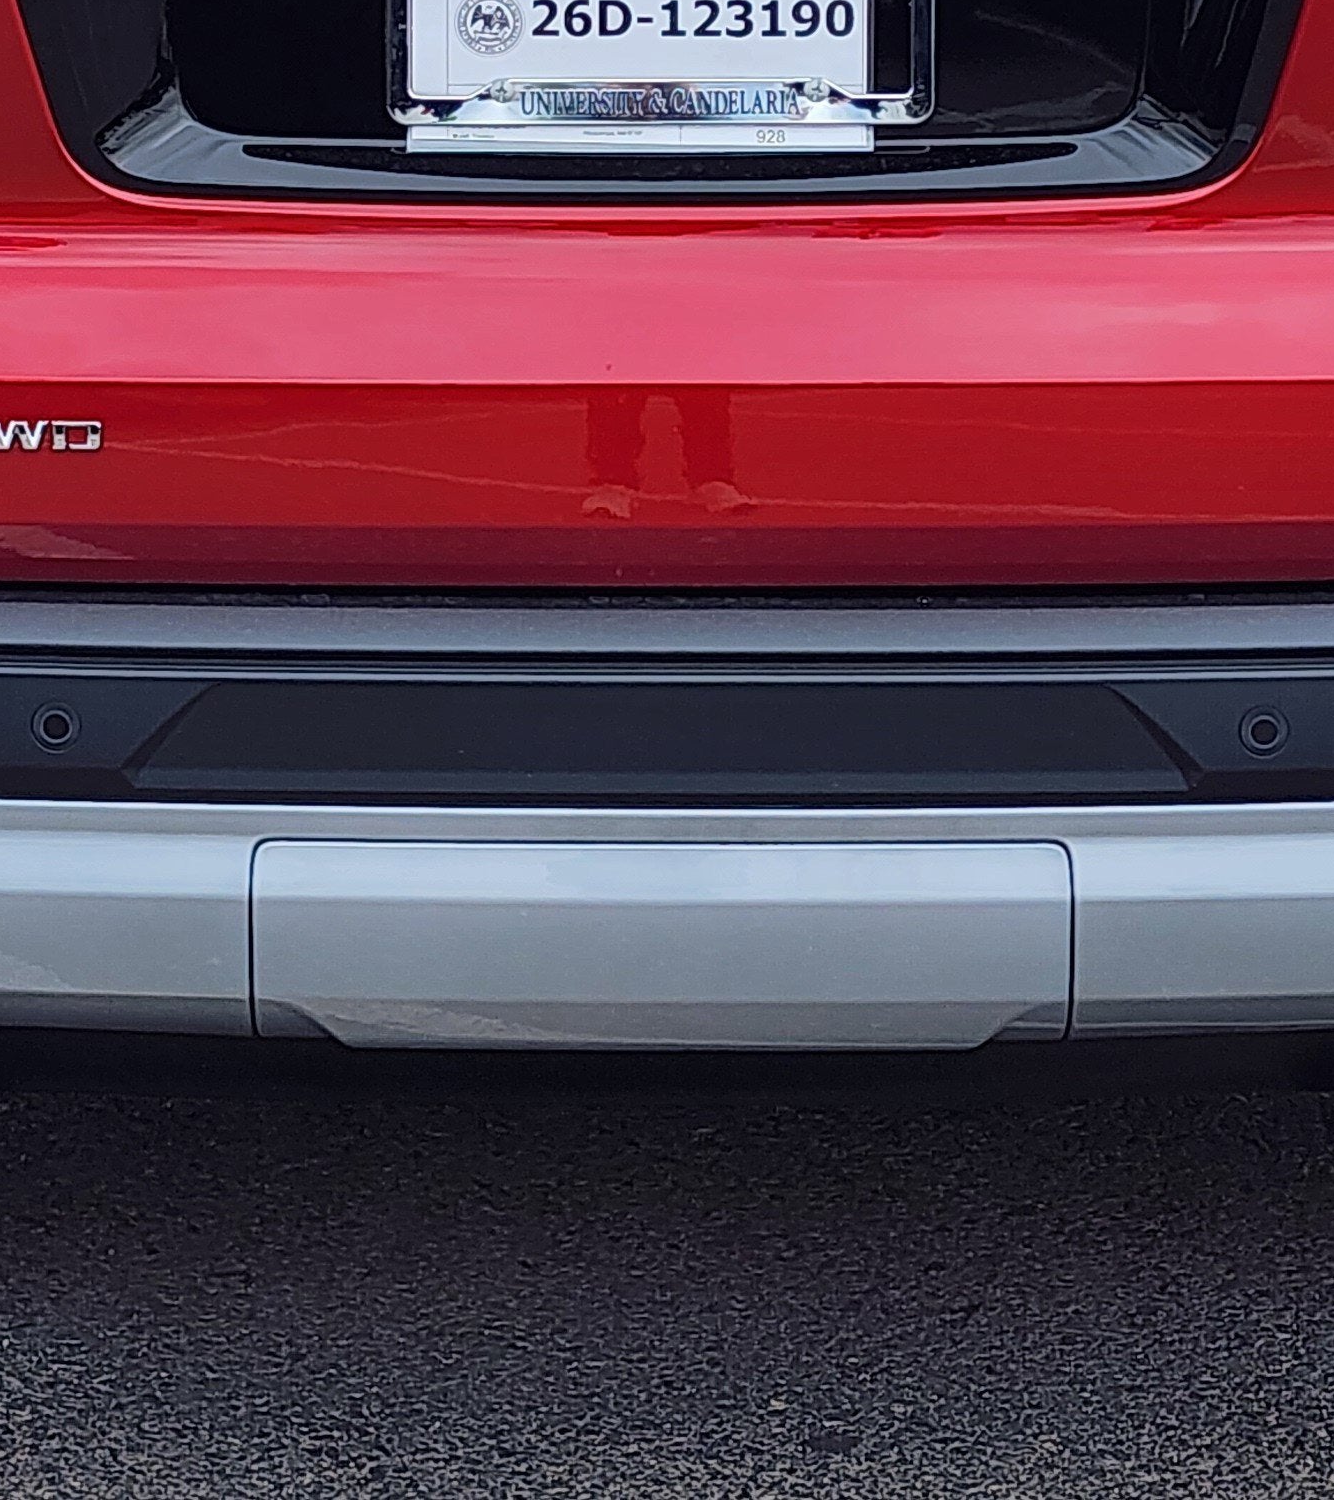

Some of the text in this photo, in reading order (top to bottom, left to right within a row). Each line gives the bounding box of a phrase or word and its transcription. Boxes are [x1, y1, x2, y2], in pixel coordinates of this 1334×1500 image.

[531, 0, 855, 38] 26D-123190
[520, 88, 802, 116] UNIVERSITY & CANDELARIA
[756, 130, 786, 144] 928
